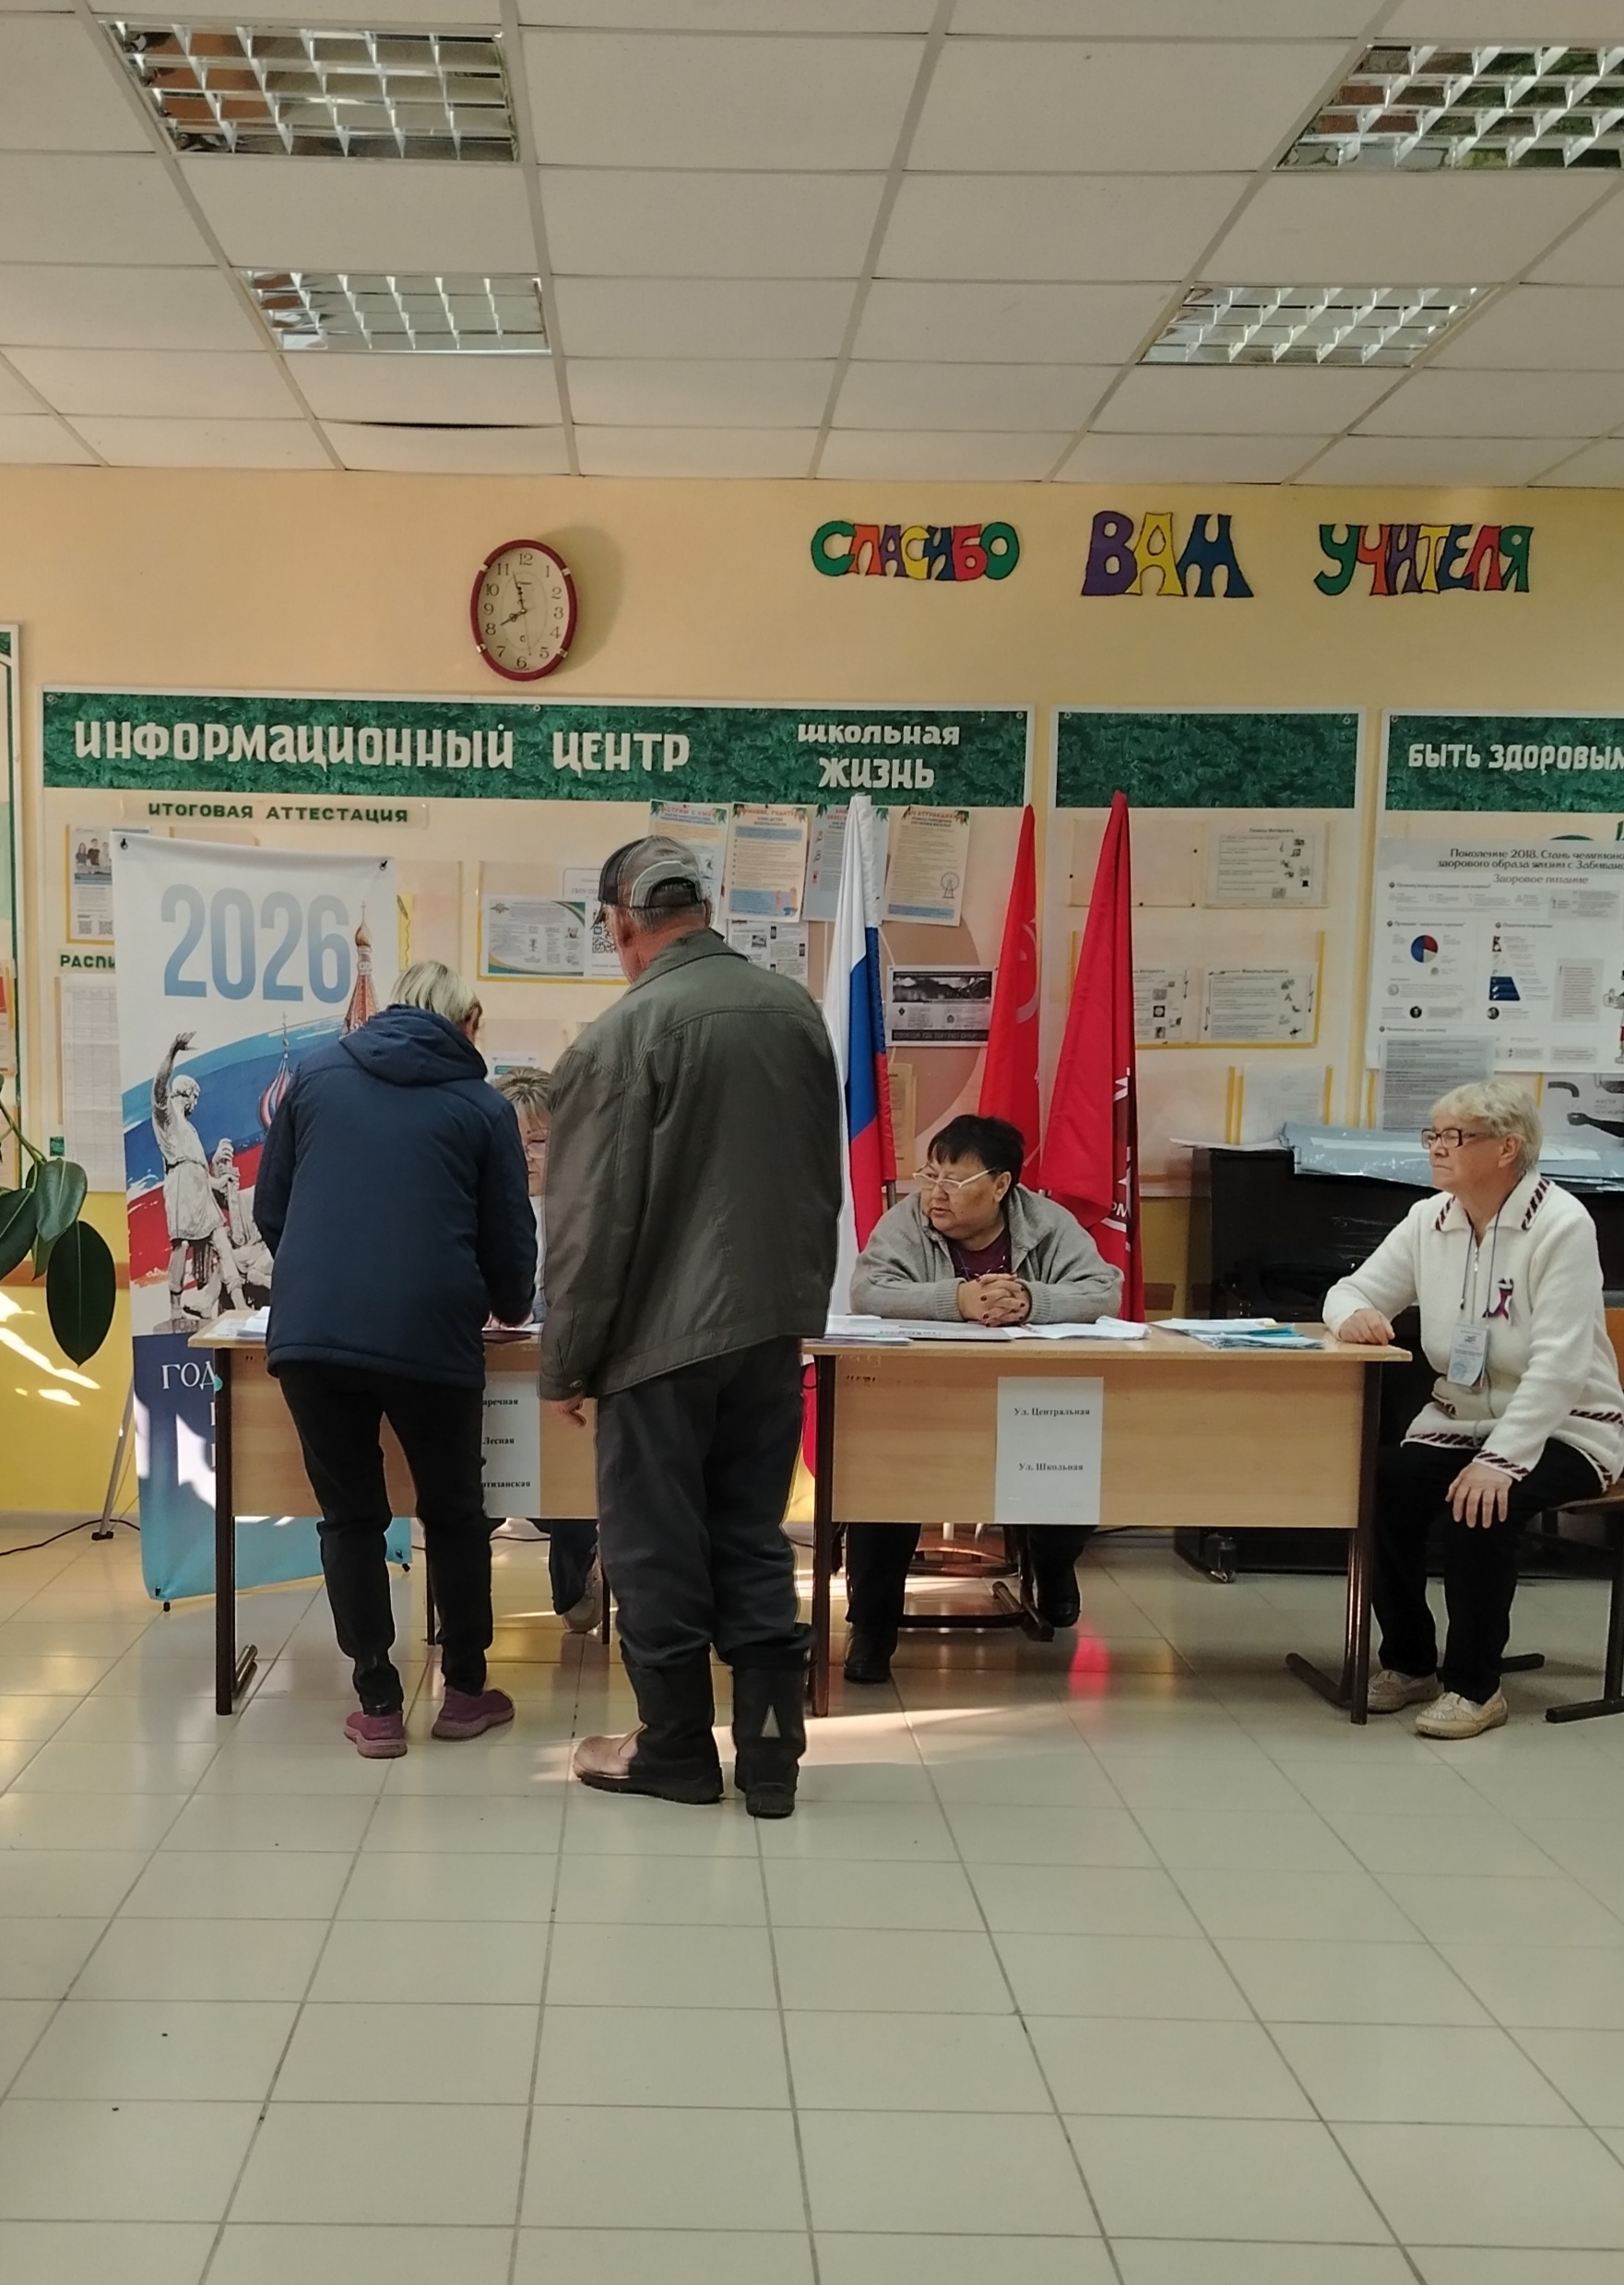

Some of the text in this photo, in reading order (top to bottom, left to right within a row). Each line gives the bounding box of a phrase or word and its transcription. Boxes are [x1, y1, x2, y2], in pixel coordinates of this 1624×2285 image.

[519, 553, 533, 566] 12
[811, 511, 1534, 598] СПАСИБО ВАМ УЧИТЕЛЯ
[496, 563, 509, 576] 11
[486, 583, 500, 597] 10
[551, 586, 562, 599] 2
[483, 603, 494, 616] 9
[553, 607, 563, 619] 3
[485, 623, 496, 635] 8
[550, 626, 562, 639] 4
[496, 645, 505, 657] 7
[539, 646, 550, 658] 5
[516, 656, 527, 669] 6
[75, 721, 690, 777] ИНФОРМАЦИОННЫЙ ЦЕНТР
[1408, 743, 1481, 768] БЫТЬ
[819, 758, 934, 789] ЖИЗНЬ
[148, 802, 408, 824] ИТОГОВАЯ АТТЕСТАЦИЯ
[1450, 848, 1508, 858] Поколение
[1511, 849, 1539, 858] 2018.
[1437, 860, 1489, 870] здорового
[1491, 859, 1530, 870] образа
[1492, 874, 1544, 885] Здоровое
[160, 884, 351, 1004] 2026
[1032, 1408, 1090, 1417] Центральная
[1019, 1462, 1084, 1471] Ул. Школьная
